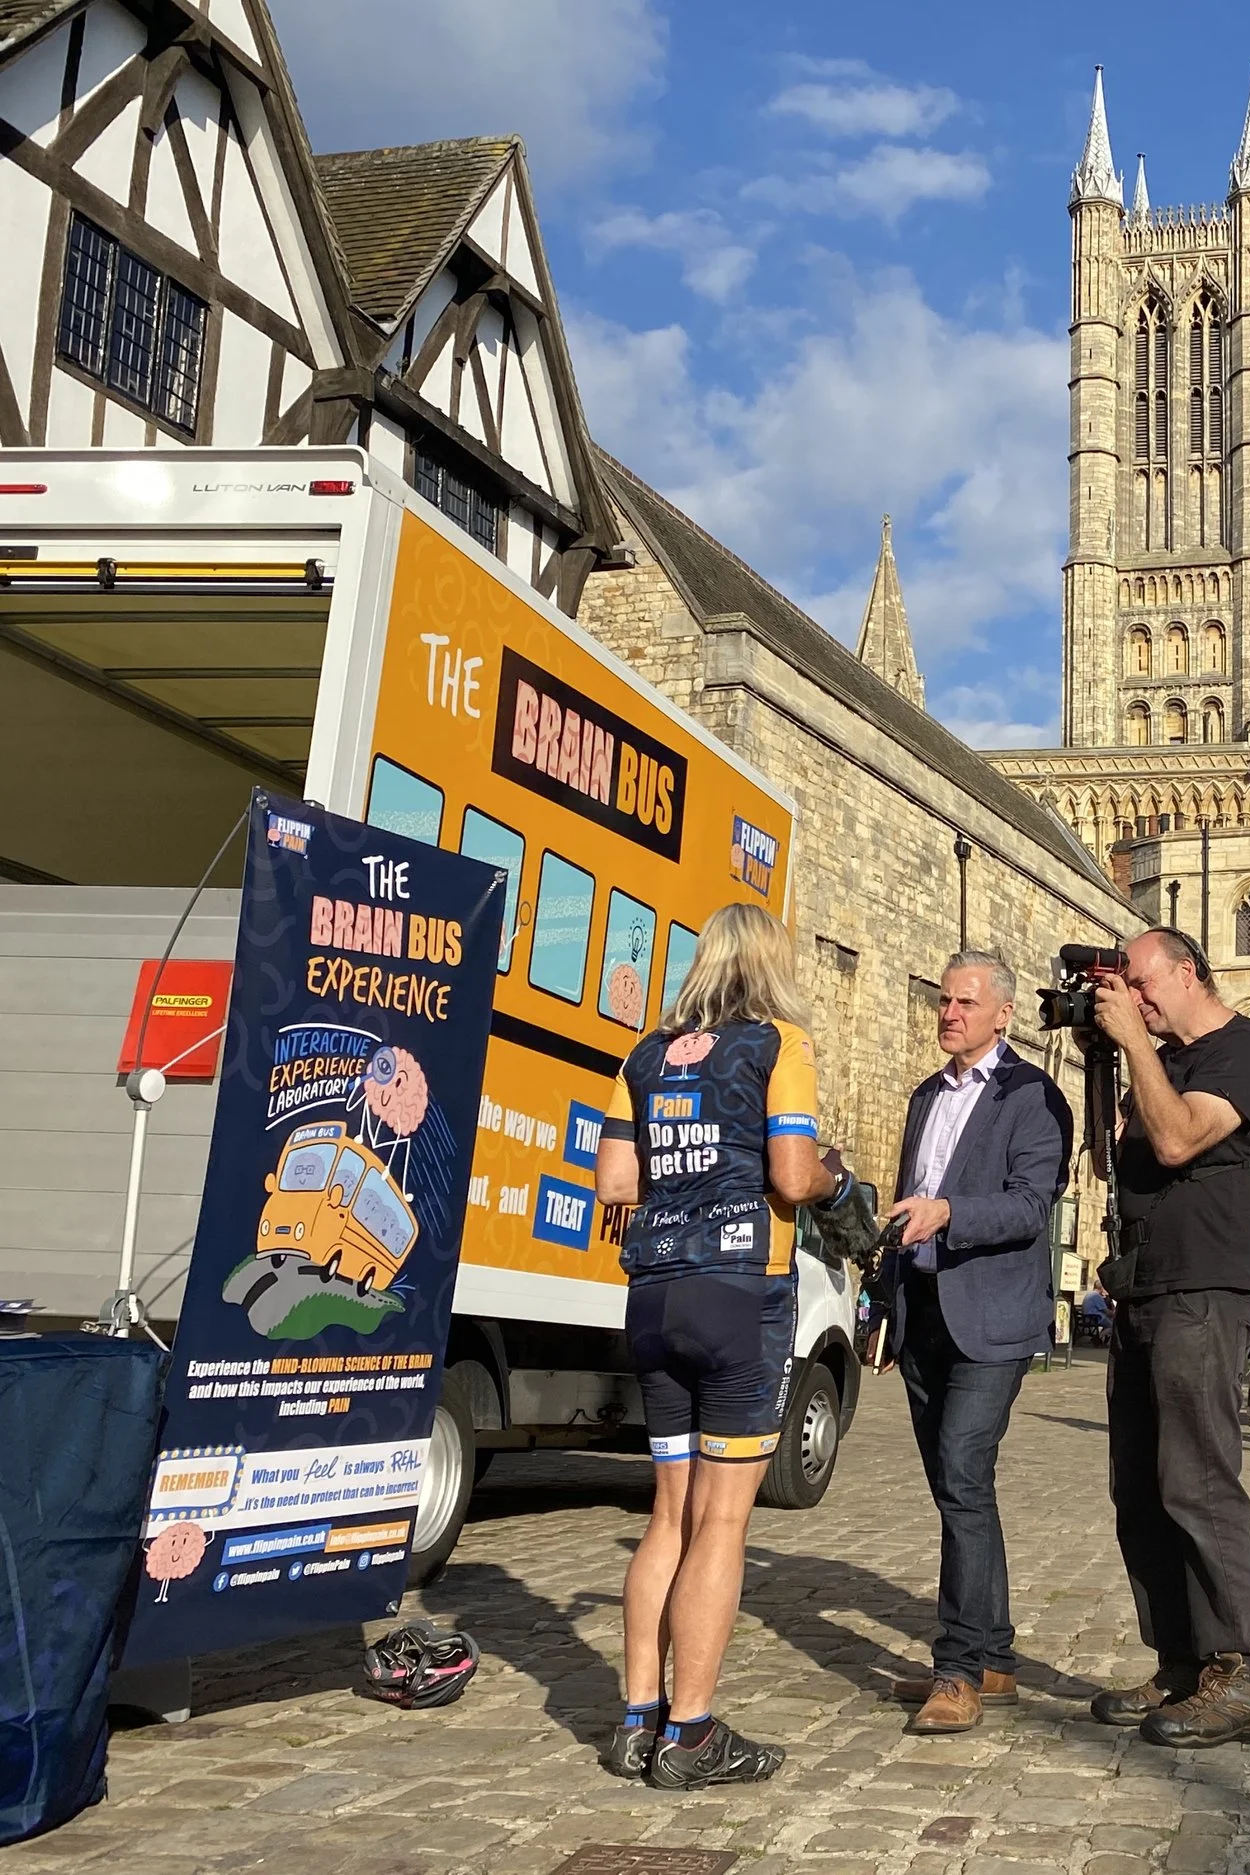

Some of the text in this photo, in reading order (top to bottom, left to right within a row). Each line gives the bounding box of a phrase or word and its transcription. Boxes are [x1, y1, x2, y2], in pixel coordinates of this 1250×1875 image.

[193, 483, 306, 492] LUTON VAN
[419, 632, 484, 719] THE
[511, 679, 675, 835] BRAIN BUS
[283, 834, 305, 853] PAIN
[362, 855, 410, 901] THE
[745, 856, 770, 893] PAIN
[310, 895, 463, 967] BRAIN BUS
[155, 997, 208, 1005] PALFINGER
[307, 957, 452, 1023] EXPERIENCE
[274, 1031, 371, 1065] INTERACTIVE
[269, 1056, 366, 1093] EXPERIENCE
[267, 1077, 350, 1118] LABORATORY
[652, 1095, 693, 1118] Pain
[293, 1127, 335, 1143] BRAIN BUS
[478, 1095, 502, 1132] the
[504, 1109, 535, 1147] way
[535, 1121, 557, 1152] we
[649, 1123, 720, 1149] Do you
[650, 1147, 718, 1181] get it?
[499, 1184, 529, 1216] and
[545, 1190, 586, 1232] TREAT
[600, 1204, 632, 1247] PAI
[652, 1200, 760, 1228] Educate Empower
[731, 1233, 752, 1244] Pain
[187, 1354, 433, 1378] Experience the MIND-BLOWING SCIENCE OF THE BRAIN
[189, 1374, 425, 1399] and how this impacts our experience of the world,
[279, 1398, 350, 1416] including PAIN
[252, 1450, 421, 1484] What you feel is always REAL
[159, 1470, 229, 1493] REMEMBER
[260, 1495, 275, 1508] the
[277, 1493, 300, 1507] need
[301, 1493, 310, 1504] to
[311, 1489, 342, 1505] protect
[343, 1488, 359, 1500] that
[360, 1487, 374, 1498] can
[375, 1484, 385, 1496] be
[386, 1480, 418, 1495] incorrect
[228, 1530, 326, 1558] www.flippinpain.co.uk
